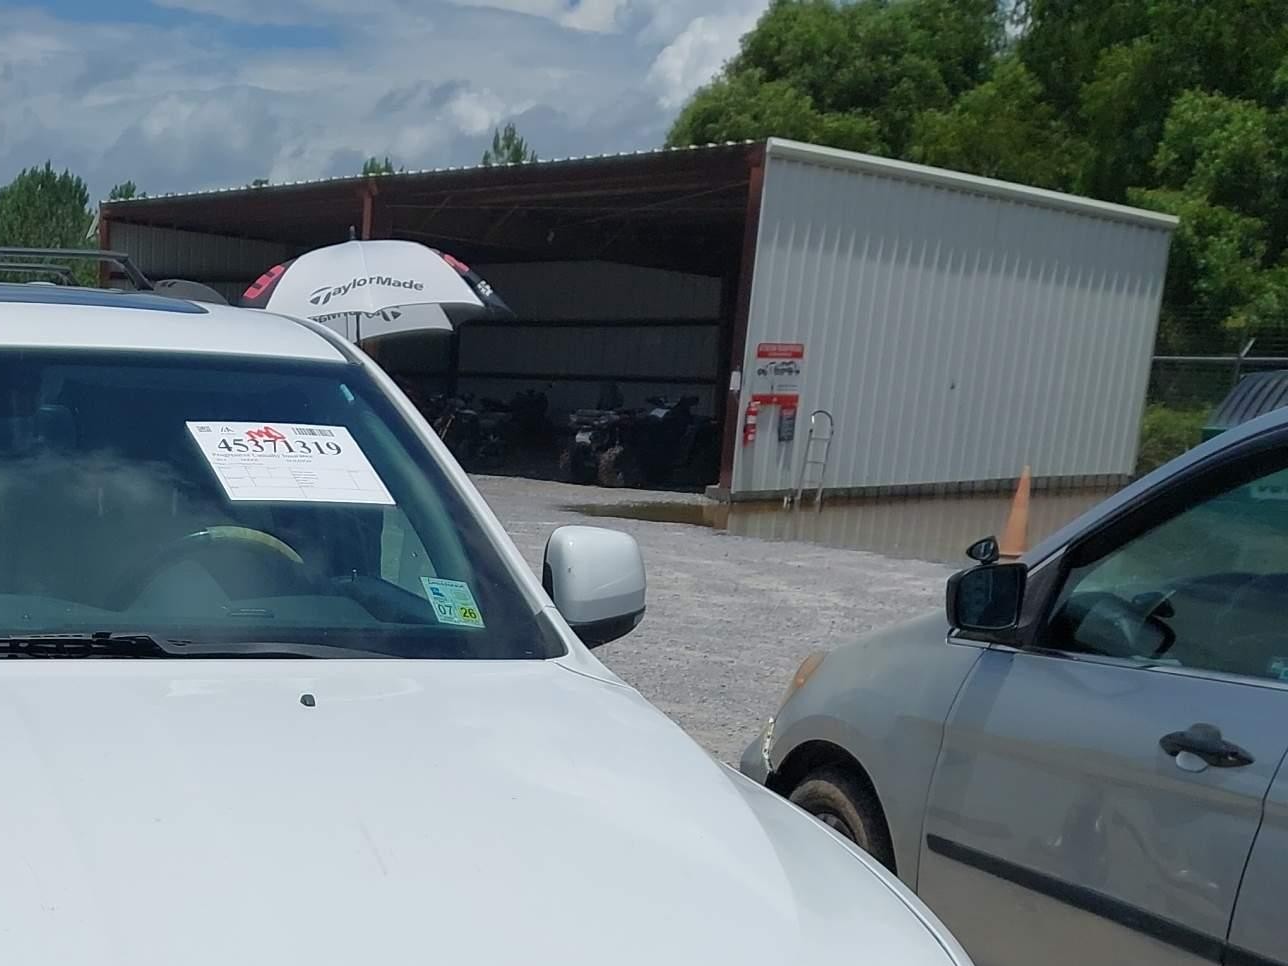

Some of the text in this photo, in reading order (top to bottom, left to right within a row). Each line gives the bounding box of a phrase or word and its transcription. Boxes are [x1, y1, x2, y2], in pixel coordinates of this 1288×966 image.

[310, 276, 425, 305] TaylorMade
[218, 438, 342, 456] 45371319
[438, 604, 477, 618] 07 26
